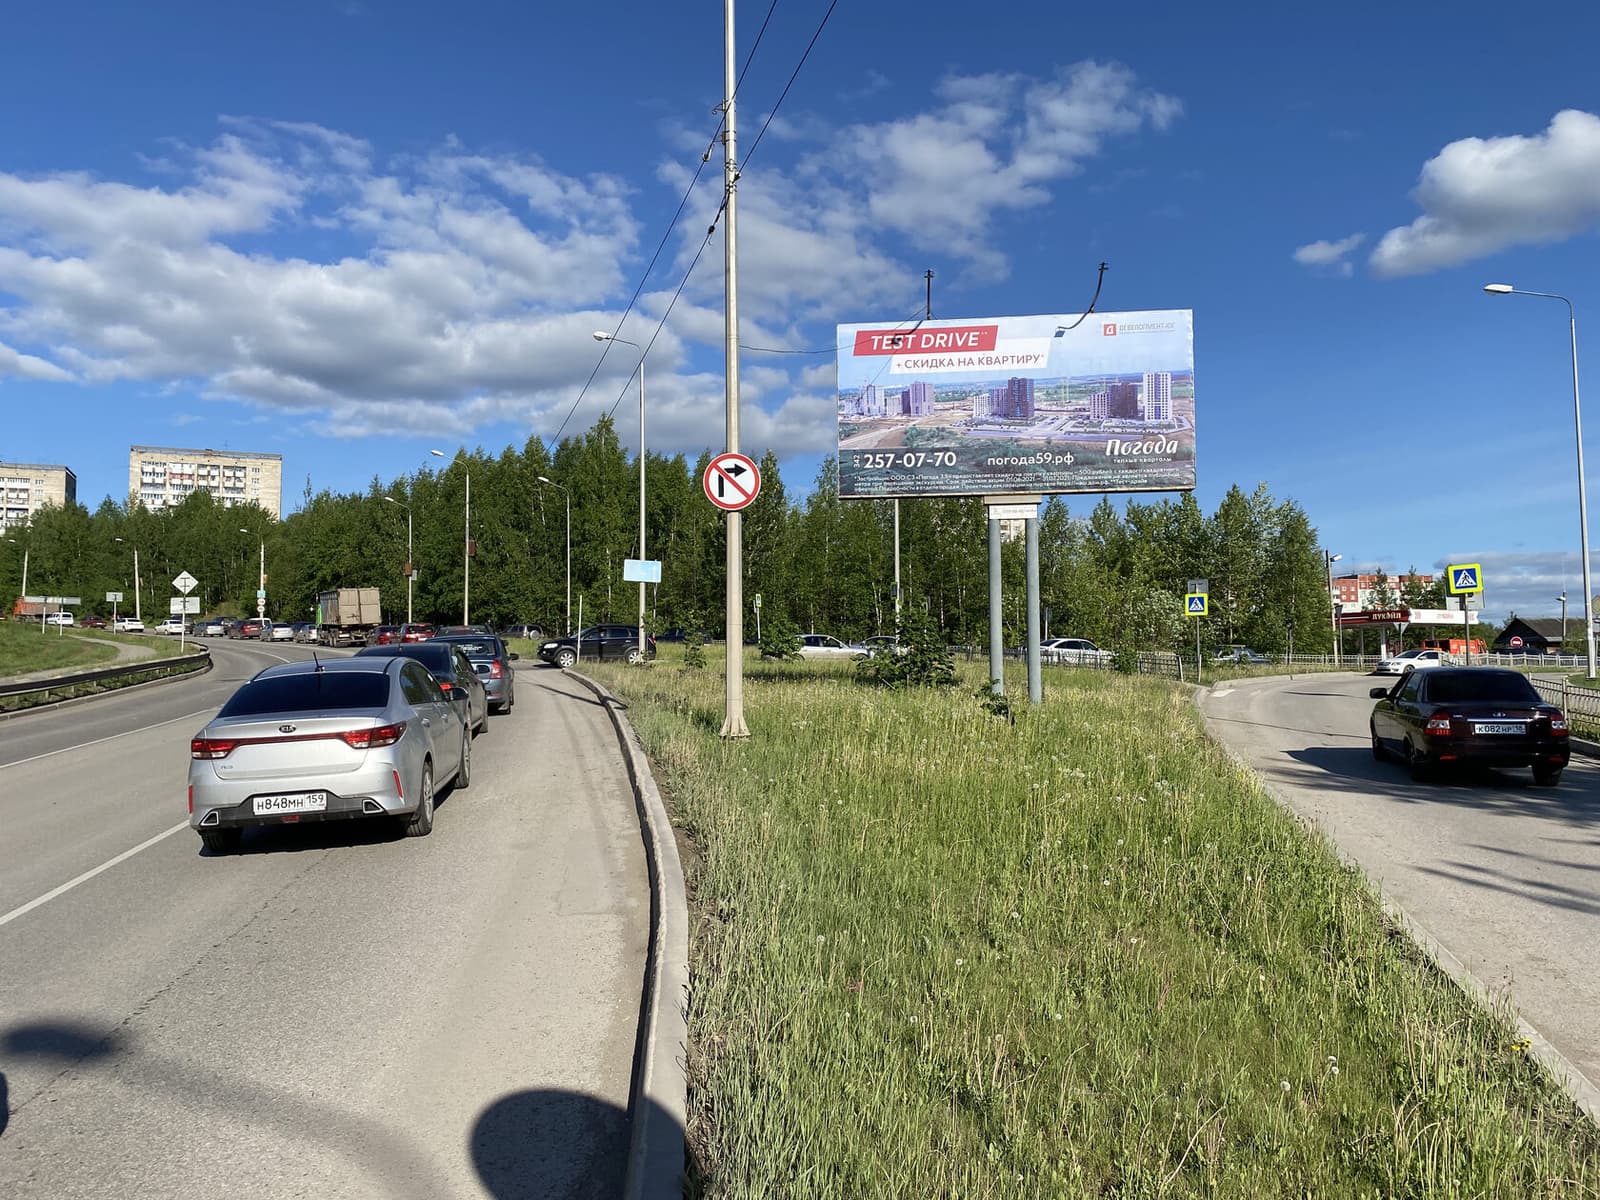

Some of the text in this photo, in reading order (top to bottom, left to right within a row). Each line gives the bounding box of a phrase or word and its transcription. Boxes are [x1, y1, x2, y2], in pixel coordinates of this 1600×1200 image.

[871, 334, 917, 350] TEST
[904, 356, 955, 369] СКИДКА
[957, 357, 975, 367] НА
[1105, 434, 1179, 457] Погода
[863, 452, 957, 469] 257-07-70
[987, 452, 1074, 467] погода59.рф
